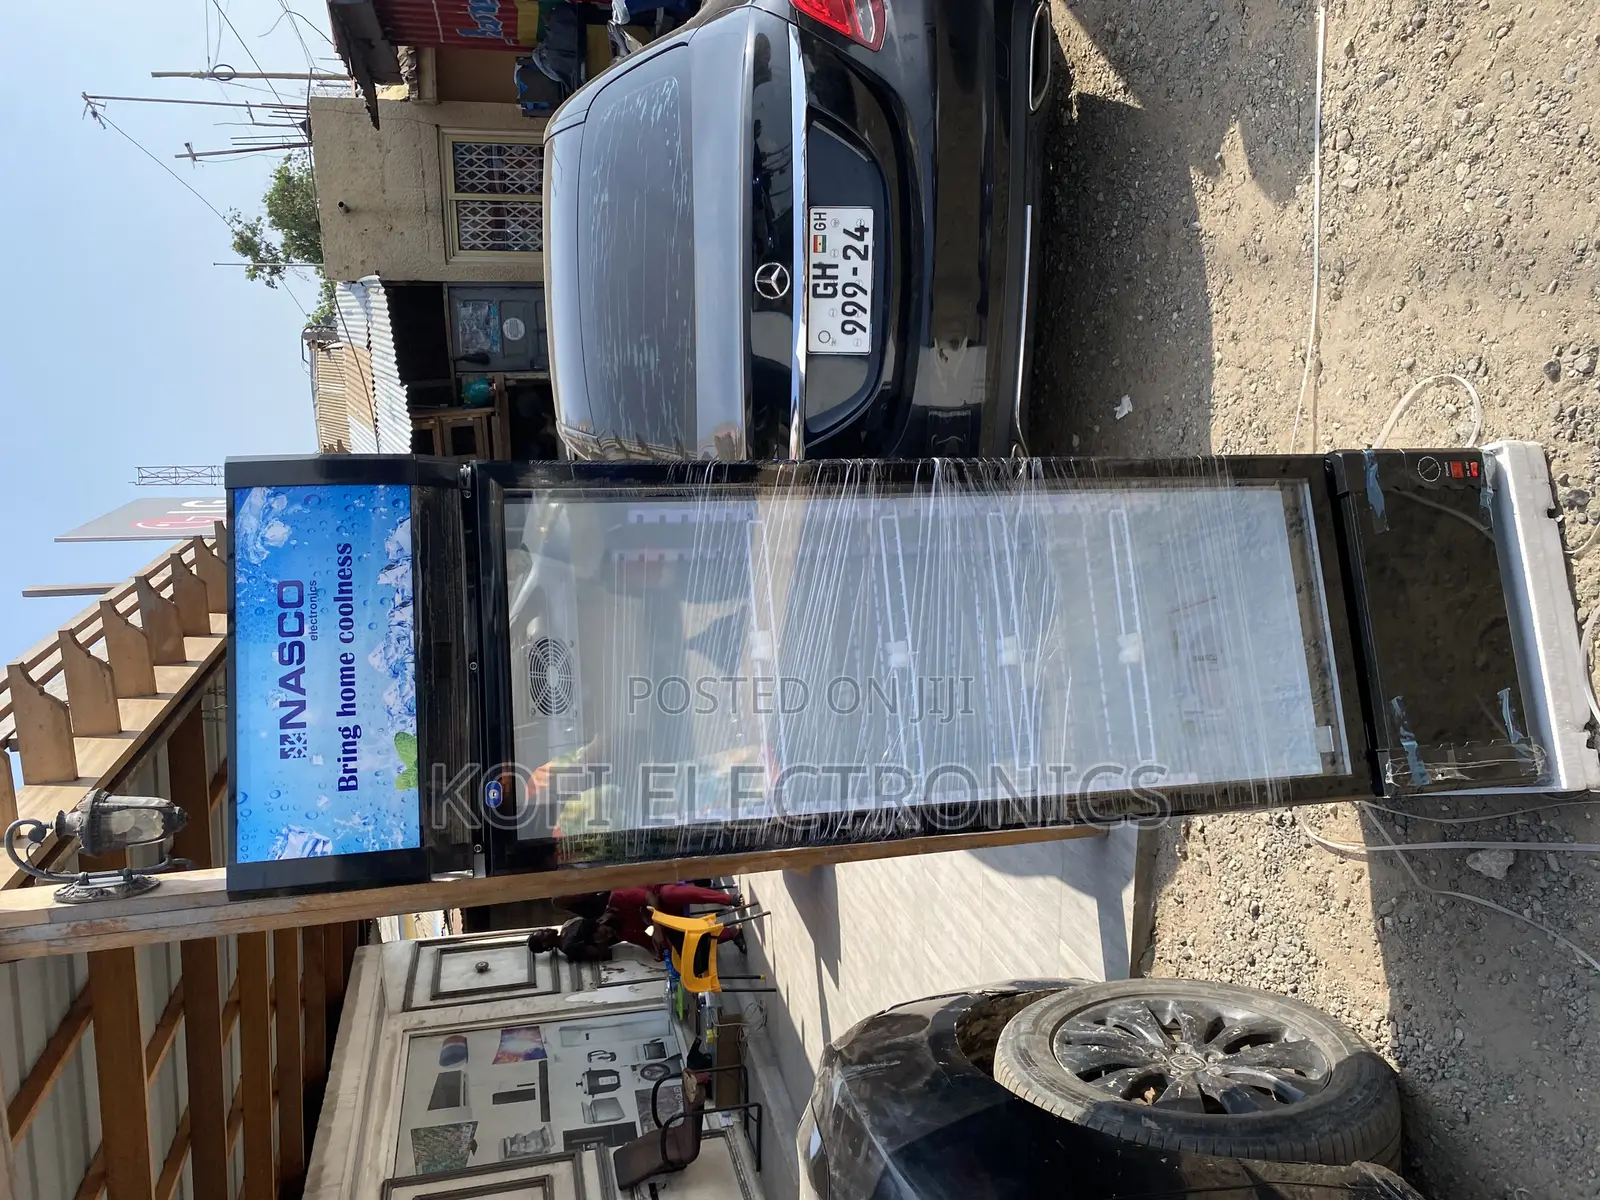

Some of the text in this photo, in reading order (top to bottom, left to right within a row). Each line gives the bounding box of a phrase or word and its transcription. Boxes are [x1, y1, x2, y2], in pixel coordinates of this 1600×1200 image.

[812, 212, 838, 298] GH GH
[841, 225, 869, 335] 999-24
[277, 580, 306, 728] NASCO
[308, 580, 318, 641] electronics
[333, 542, 361, 792] Bring home coolness
